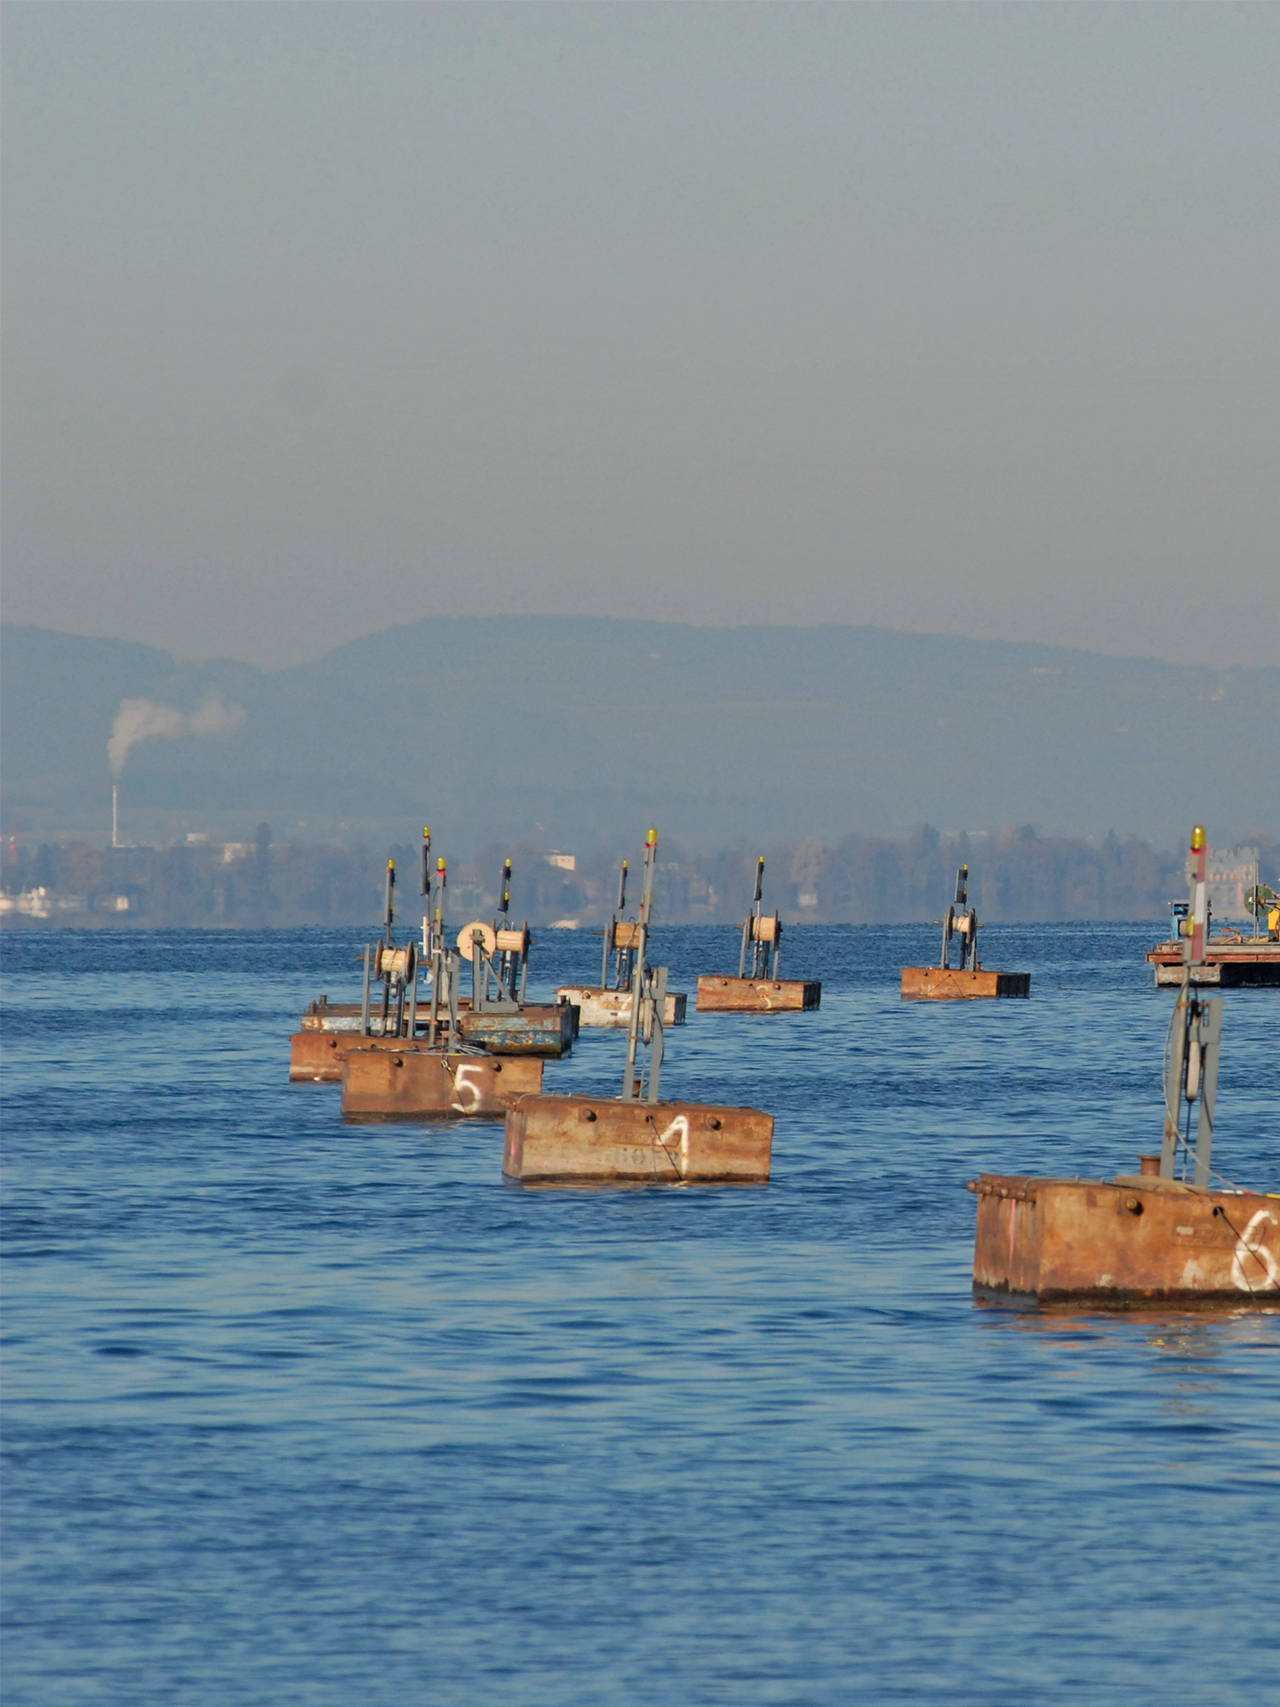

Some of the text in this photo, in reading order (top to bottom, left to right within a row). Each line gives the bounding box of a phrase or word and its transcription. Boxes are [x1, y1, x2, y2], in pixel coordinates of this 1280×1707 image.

[451, 1064, 483, 1113] 5
[656, 1115, 688, 1175] 1
[1232, 1210, 1278, 1292] 6
